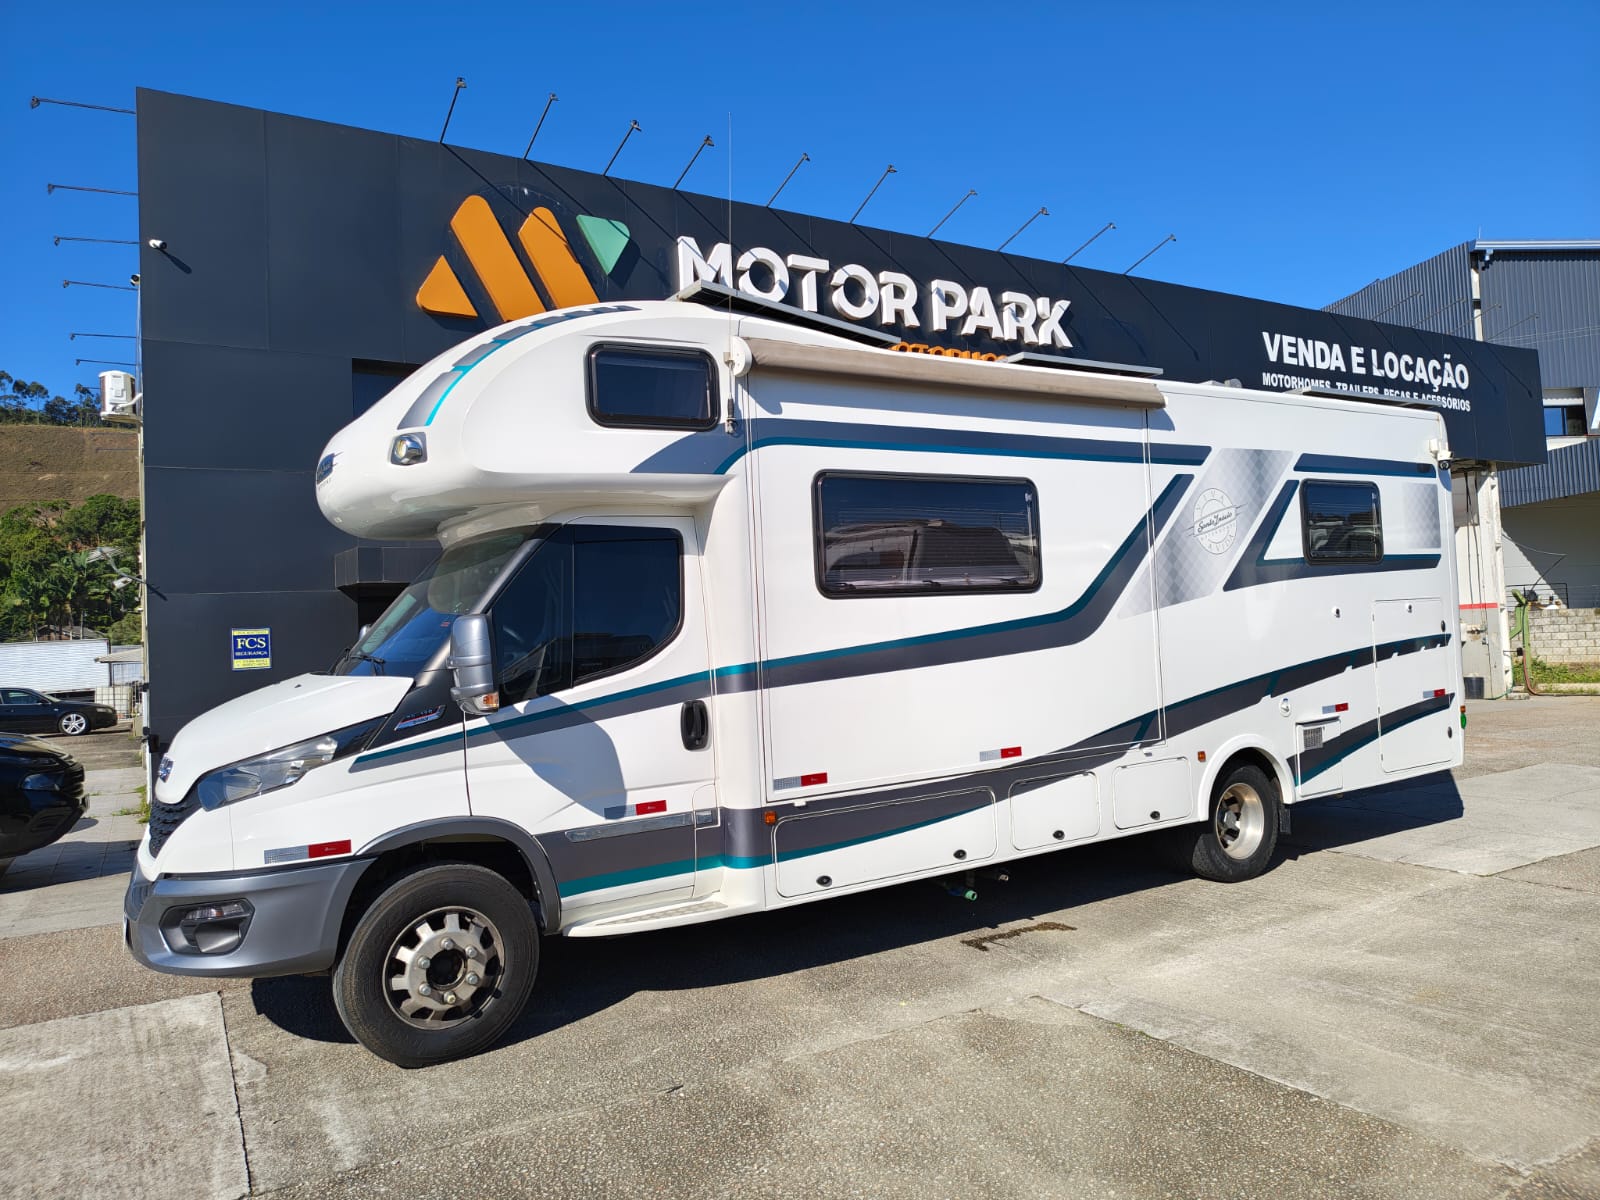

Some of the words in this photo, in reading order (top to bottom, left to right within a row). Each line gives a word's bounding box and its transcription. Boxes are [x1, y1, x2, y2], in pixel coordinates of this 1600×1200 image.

[677, 236, 919, 327] MOTOR
[931, 279, 1073, 348] PARK
[1262, 331, 1346, 372] VENDA
[1351, 345, 1366, 374] E
[1371, 348, 1470, 392] LOCAÇÃO
[236, 637, 266, 649] FCS
